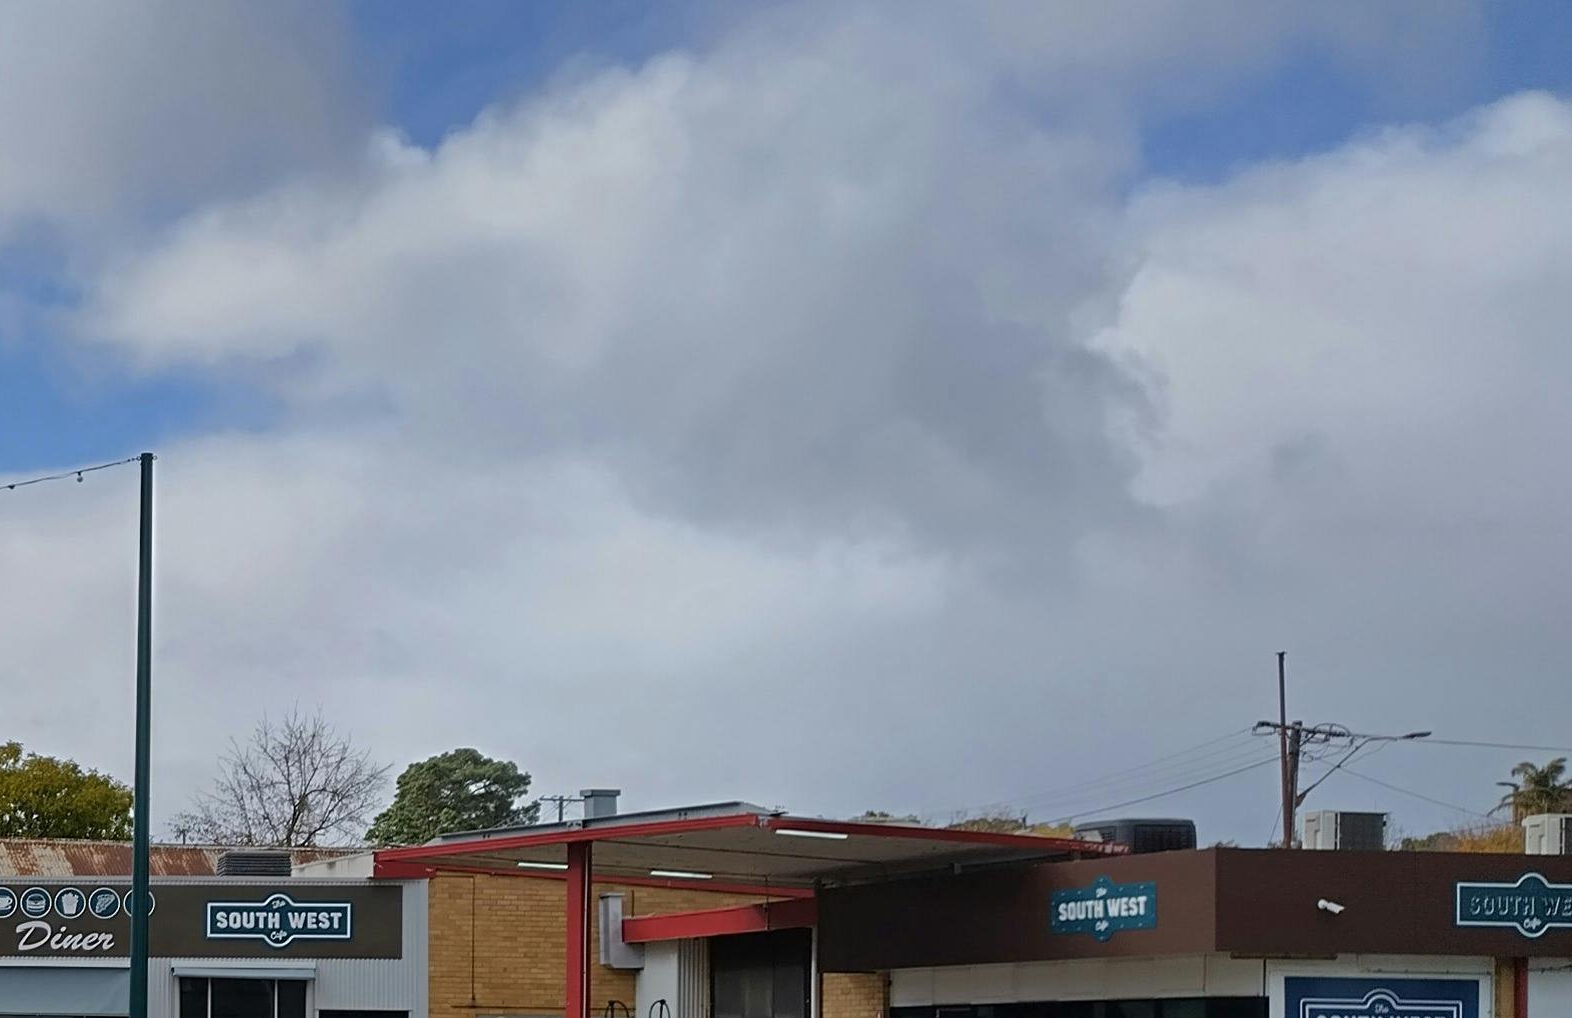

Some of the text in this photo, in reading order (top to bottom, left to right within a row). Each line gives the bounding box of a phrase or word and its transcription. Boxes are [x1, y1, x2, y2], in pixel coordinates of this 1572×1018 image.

[1058, 896, 1147, 921] SOUTH WEST
[1470, 896, 1572, 916] SOUTH WE
[215, 911, 342, 929] SOUTH WEST
[15, 920, 115, 951] Diner
